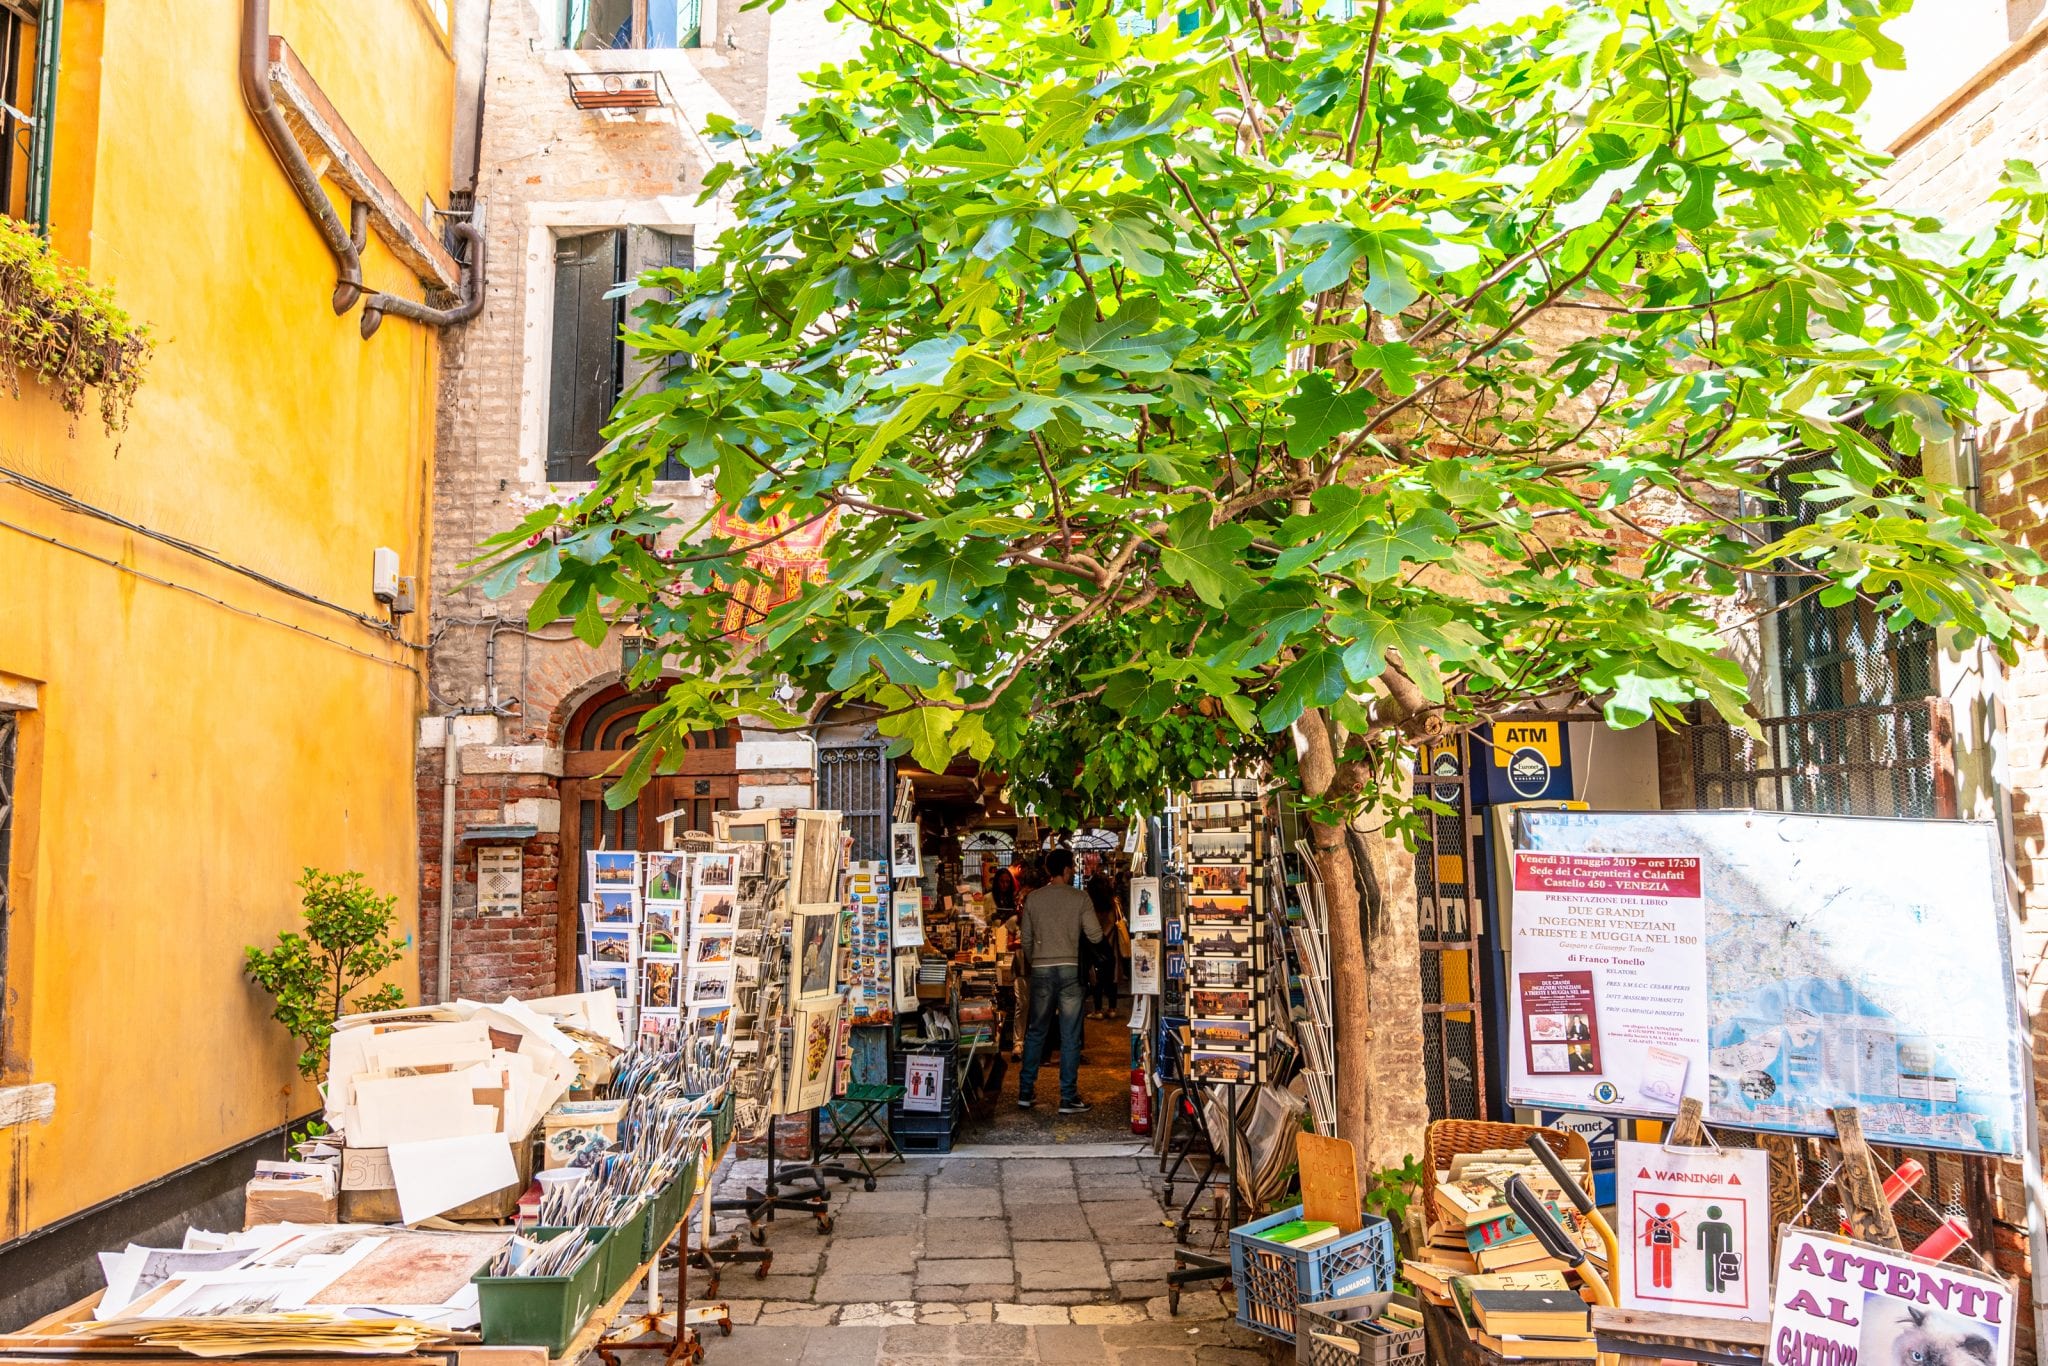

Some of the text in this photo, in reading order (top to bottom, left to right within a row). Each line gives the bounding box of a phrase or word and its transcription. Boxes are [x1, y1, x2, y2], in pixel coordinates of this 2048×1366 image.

[1506, 727, 1547, 743] ATM
[1559, 856, 1571, 865] 31
[1573, 857, 1611, 868] maggio
[1612, 858, 1637, 867] 2019
[1647, 860, 1665, 868] ore
[1668, 858, 1697, 868] 17:30
[1529, 865, 1553, 876] Sede
[1555, 866, 1571, 876] dei
[1573, 867, 1631, 879] Carpentieri
[1642, 869, 1686, 880] Calafati
[1543, 877, 1585, 888] Castello
[1587, 879, 1606, 889] 450
[1615, 880, 1670, 892] VENEZIA
[1545, 894, 1668, 906] PRESENTAZIONE DEL LIBRO
[1568, 906, 1645, 918] DUE GRANDI
[1538, 916, 1676, 931] INGEGNERI VENEZIANI
[1518, 927, 1697, 945] A TRIESTE E MUGGIA NEL 1800
[1559, 941, 1588, 950] Gasparo
[1595, 943, 1626, 952] Giuseppe
[1629, 945, 1655, 953] Tonello
[1567, 953, 1646, 966] di Franco Tonello
[1606, 968, 1637, 976] RELATORI
[1654, 1170, 1724, 1185] WARNING!!
[1788, 1242, 2004, 1324] ATTENTI
[1784, 1289, 1859, 1327] AL
